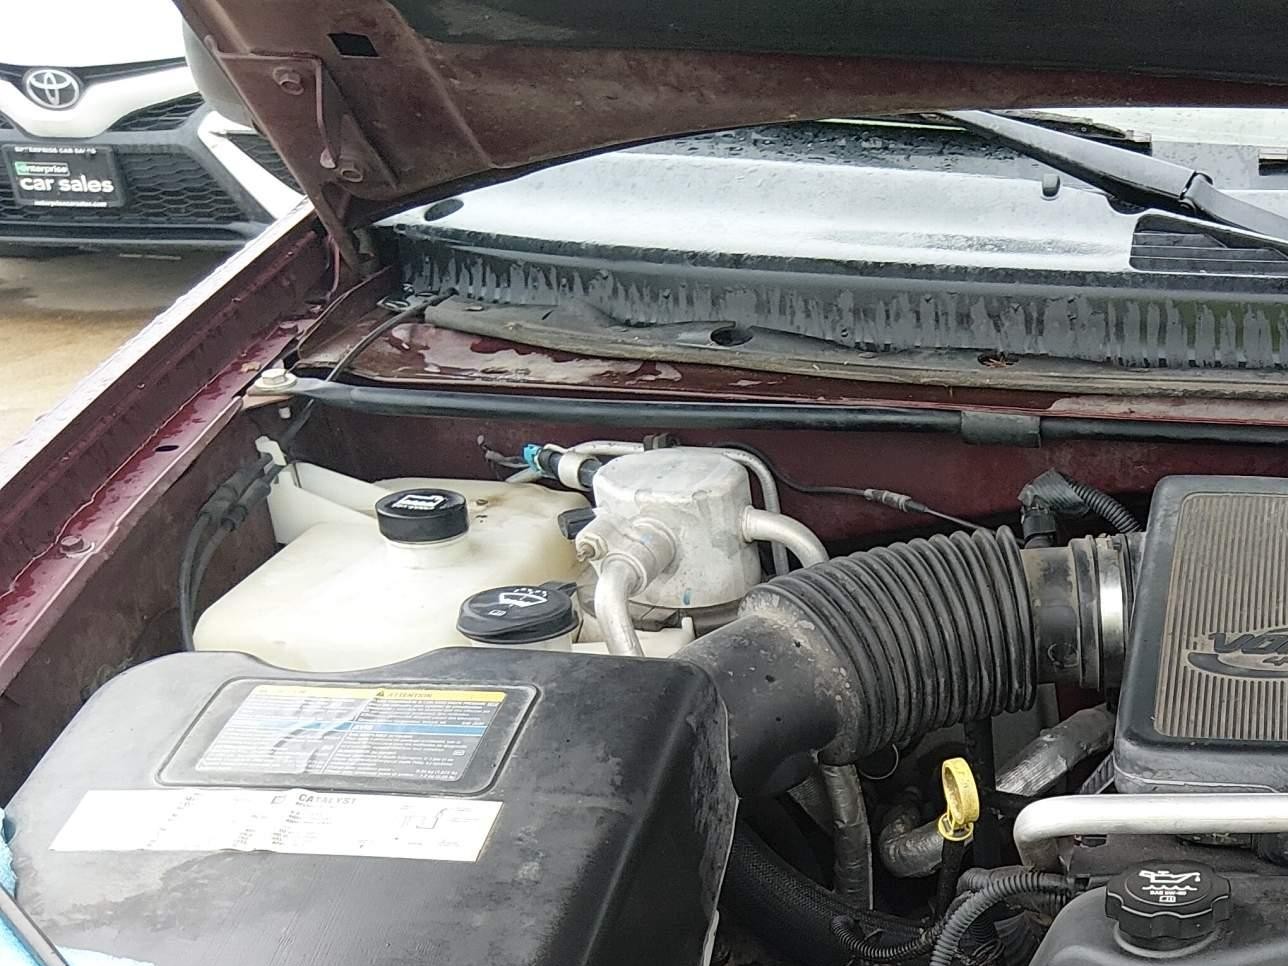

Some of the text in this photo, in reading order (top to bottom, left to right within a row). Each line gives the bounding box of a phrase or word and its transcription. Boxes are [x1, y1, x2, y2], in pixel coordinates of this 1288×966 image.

[20, 173, 114, 193] car sales
[297, 793, 357, 806] CATALYST
